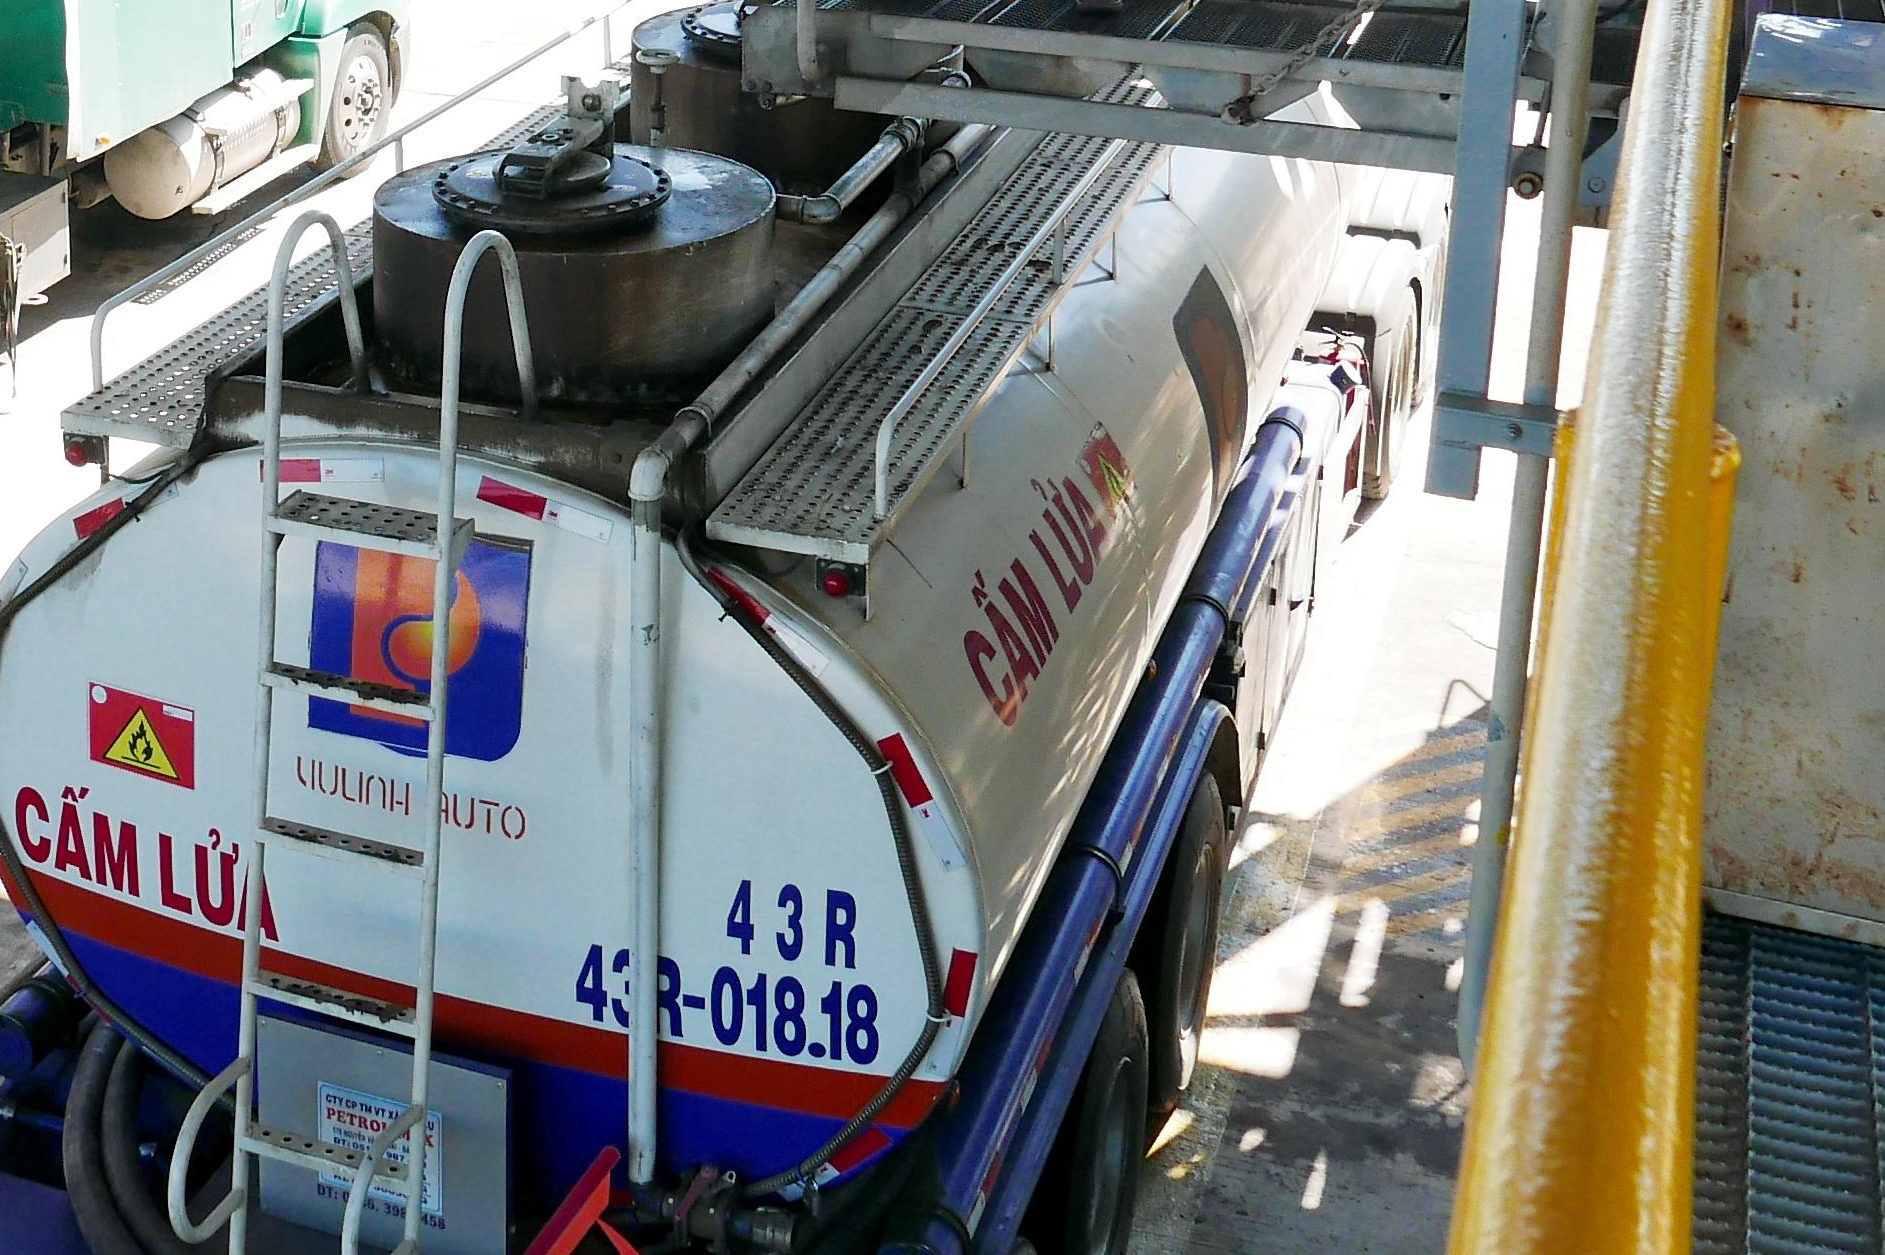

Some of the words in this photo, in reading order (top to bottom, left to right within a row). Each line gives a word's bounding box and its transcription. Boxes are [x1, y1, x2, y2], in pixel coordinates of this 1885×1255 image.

[963, 557, 1060, 727] CẤM
[1028, 476, 1108, 615] LỬA
[15, 785, 140, 898] CẤM
[325, 1093, 343, 1105] CTY
[345, 1099, 358, 1109] CP
[359, 1102, 373, 1114] TM
[374, 1107, 386, 1118] VT
